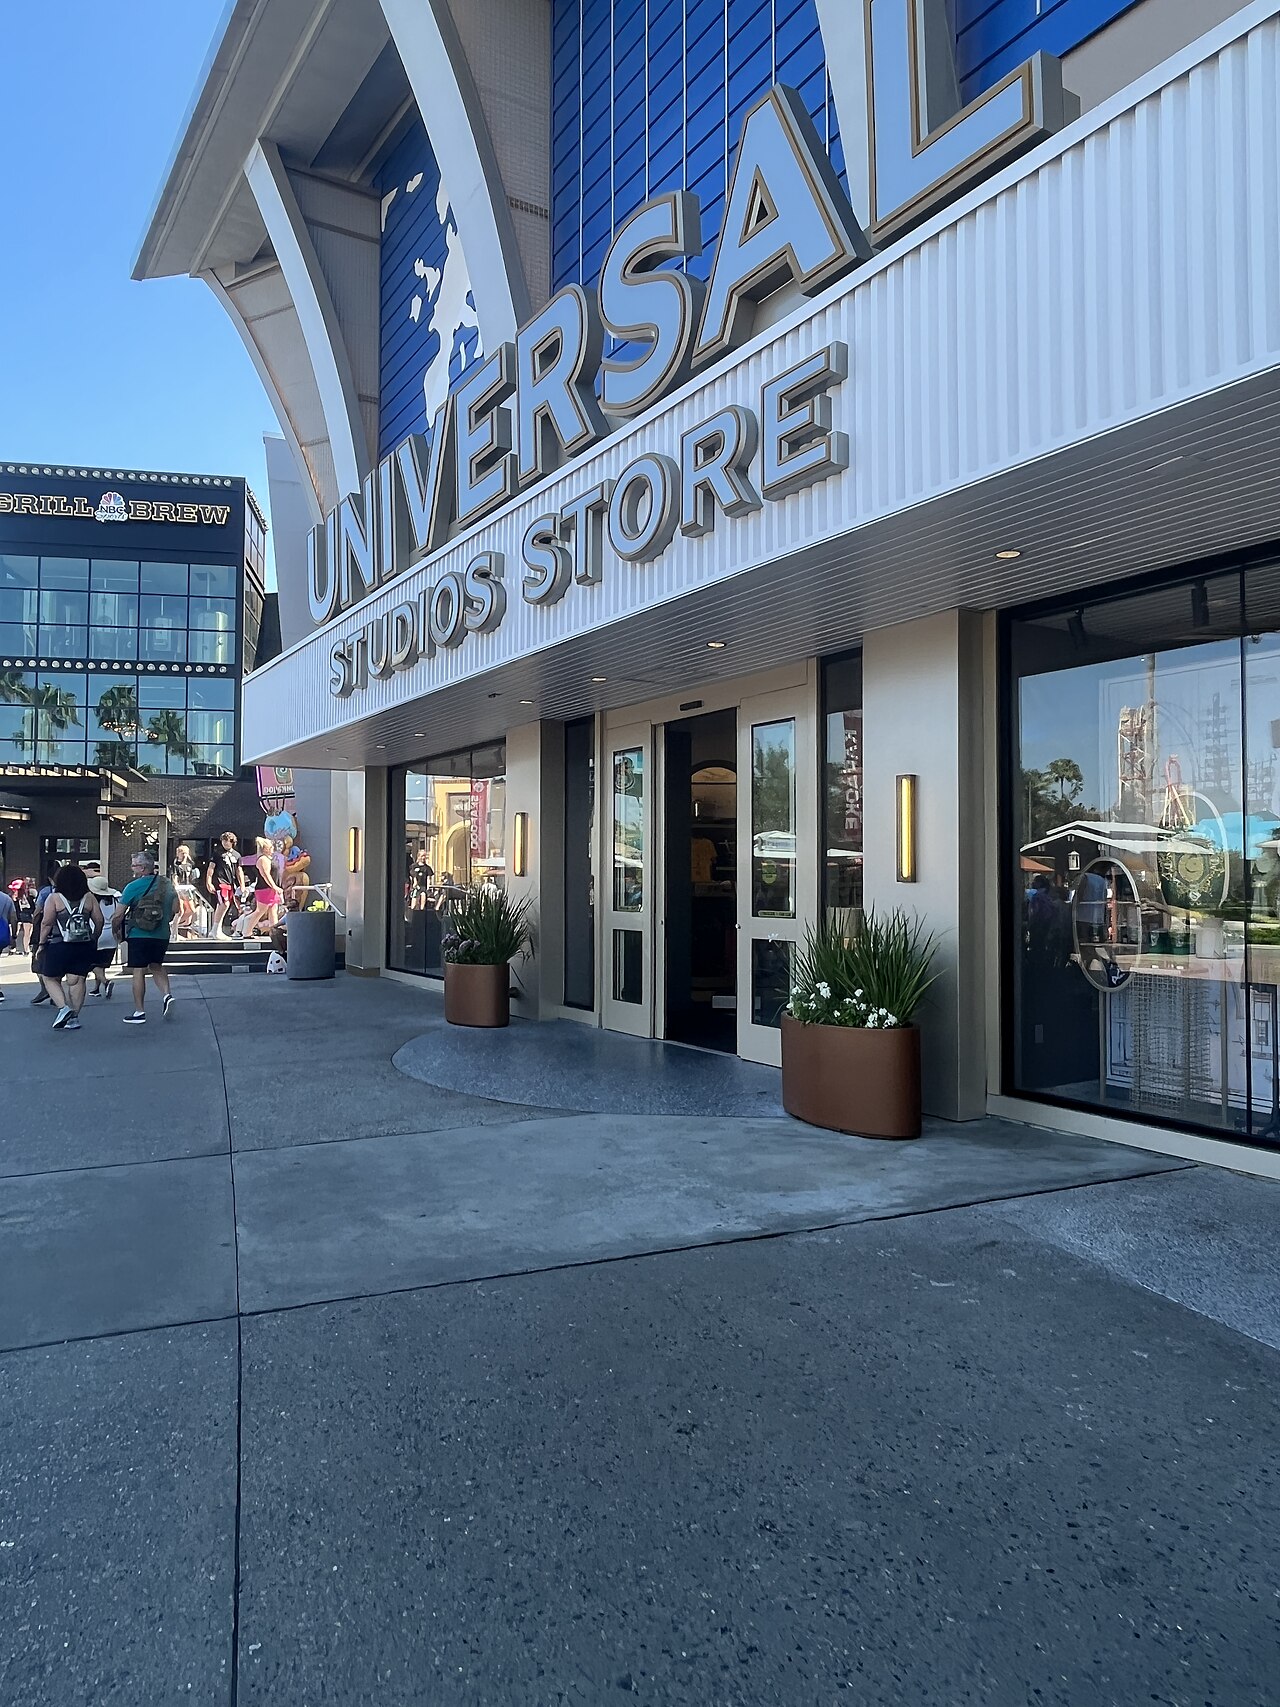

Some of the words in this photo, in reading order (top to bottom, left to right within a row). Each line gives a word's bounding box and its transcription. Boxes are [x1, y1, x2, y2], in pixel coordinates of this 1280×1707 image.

[306, 0, 1058, 627] UNIVERSAL
[100, 505, 126, 514] NBC
[128, 500, 231, 525] BREW
[329, 550, 507, 699] STUDIOS
[521, 340, 849, 606] STORE
